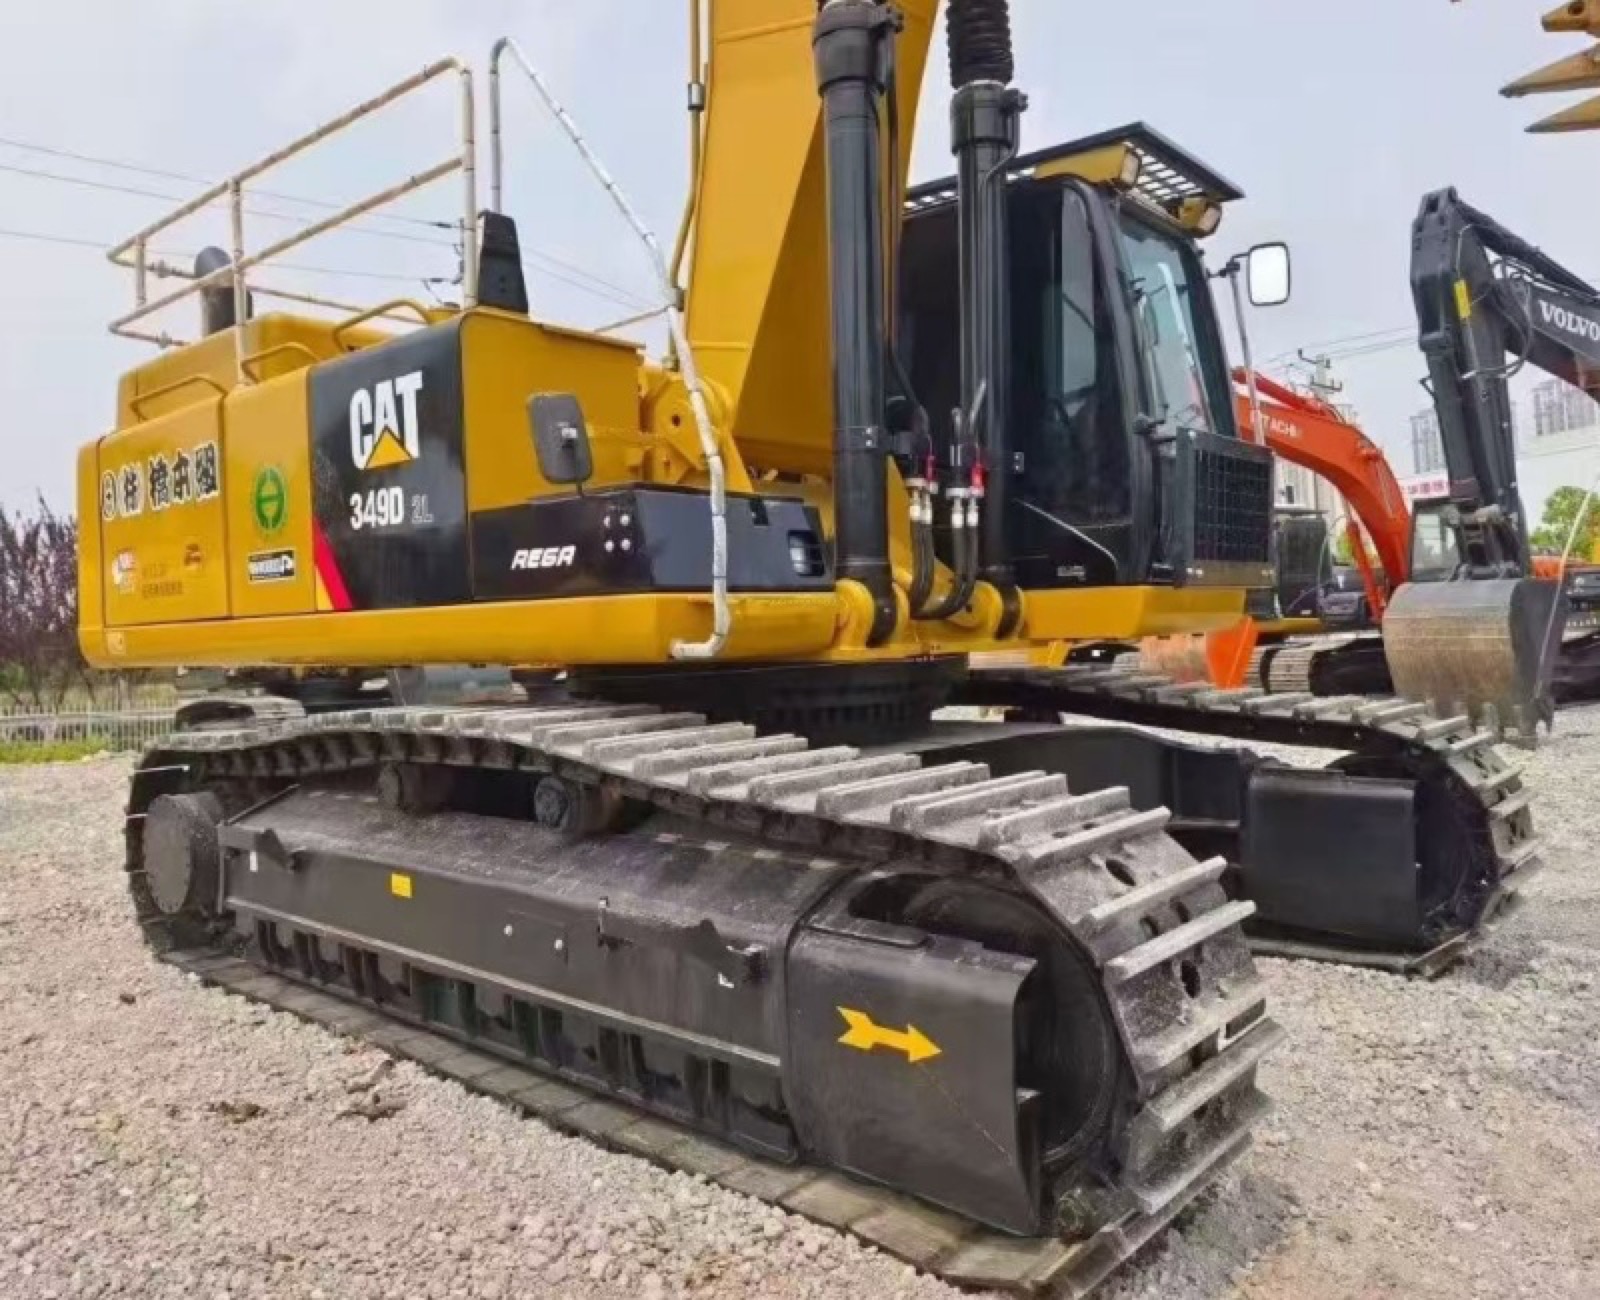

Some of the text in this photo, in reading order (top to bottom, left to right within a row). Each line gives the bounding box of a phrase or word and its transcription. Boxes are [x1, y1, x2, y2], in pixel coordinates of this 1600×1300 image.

[1538, 299, 1600, 341] VOLVO
[350, 371, 423, 471] CAT
[350, 486, 405, 531] 349D
